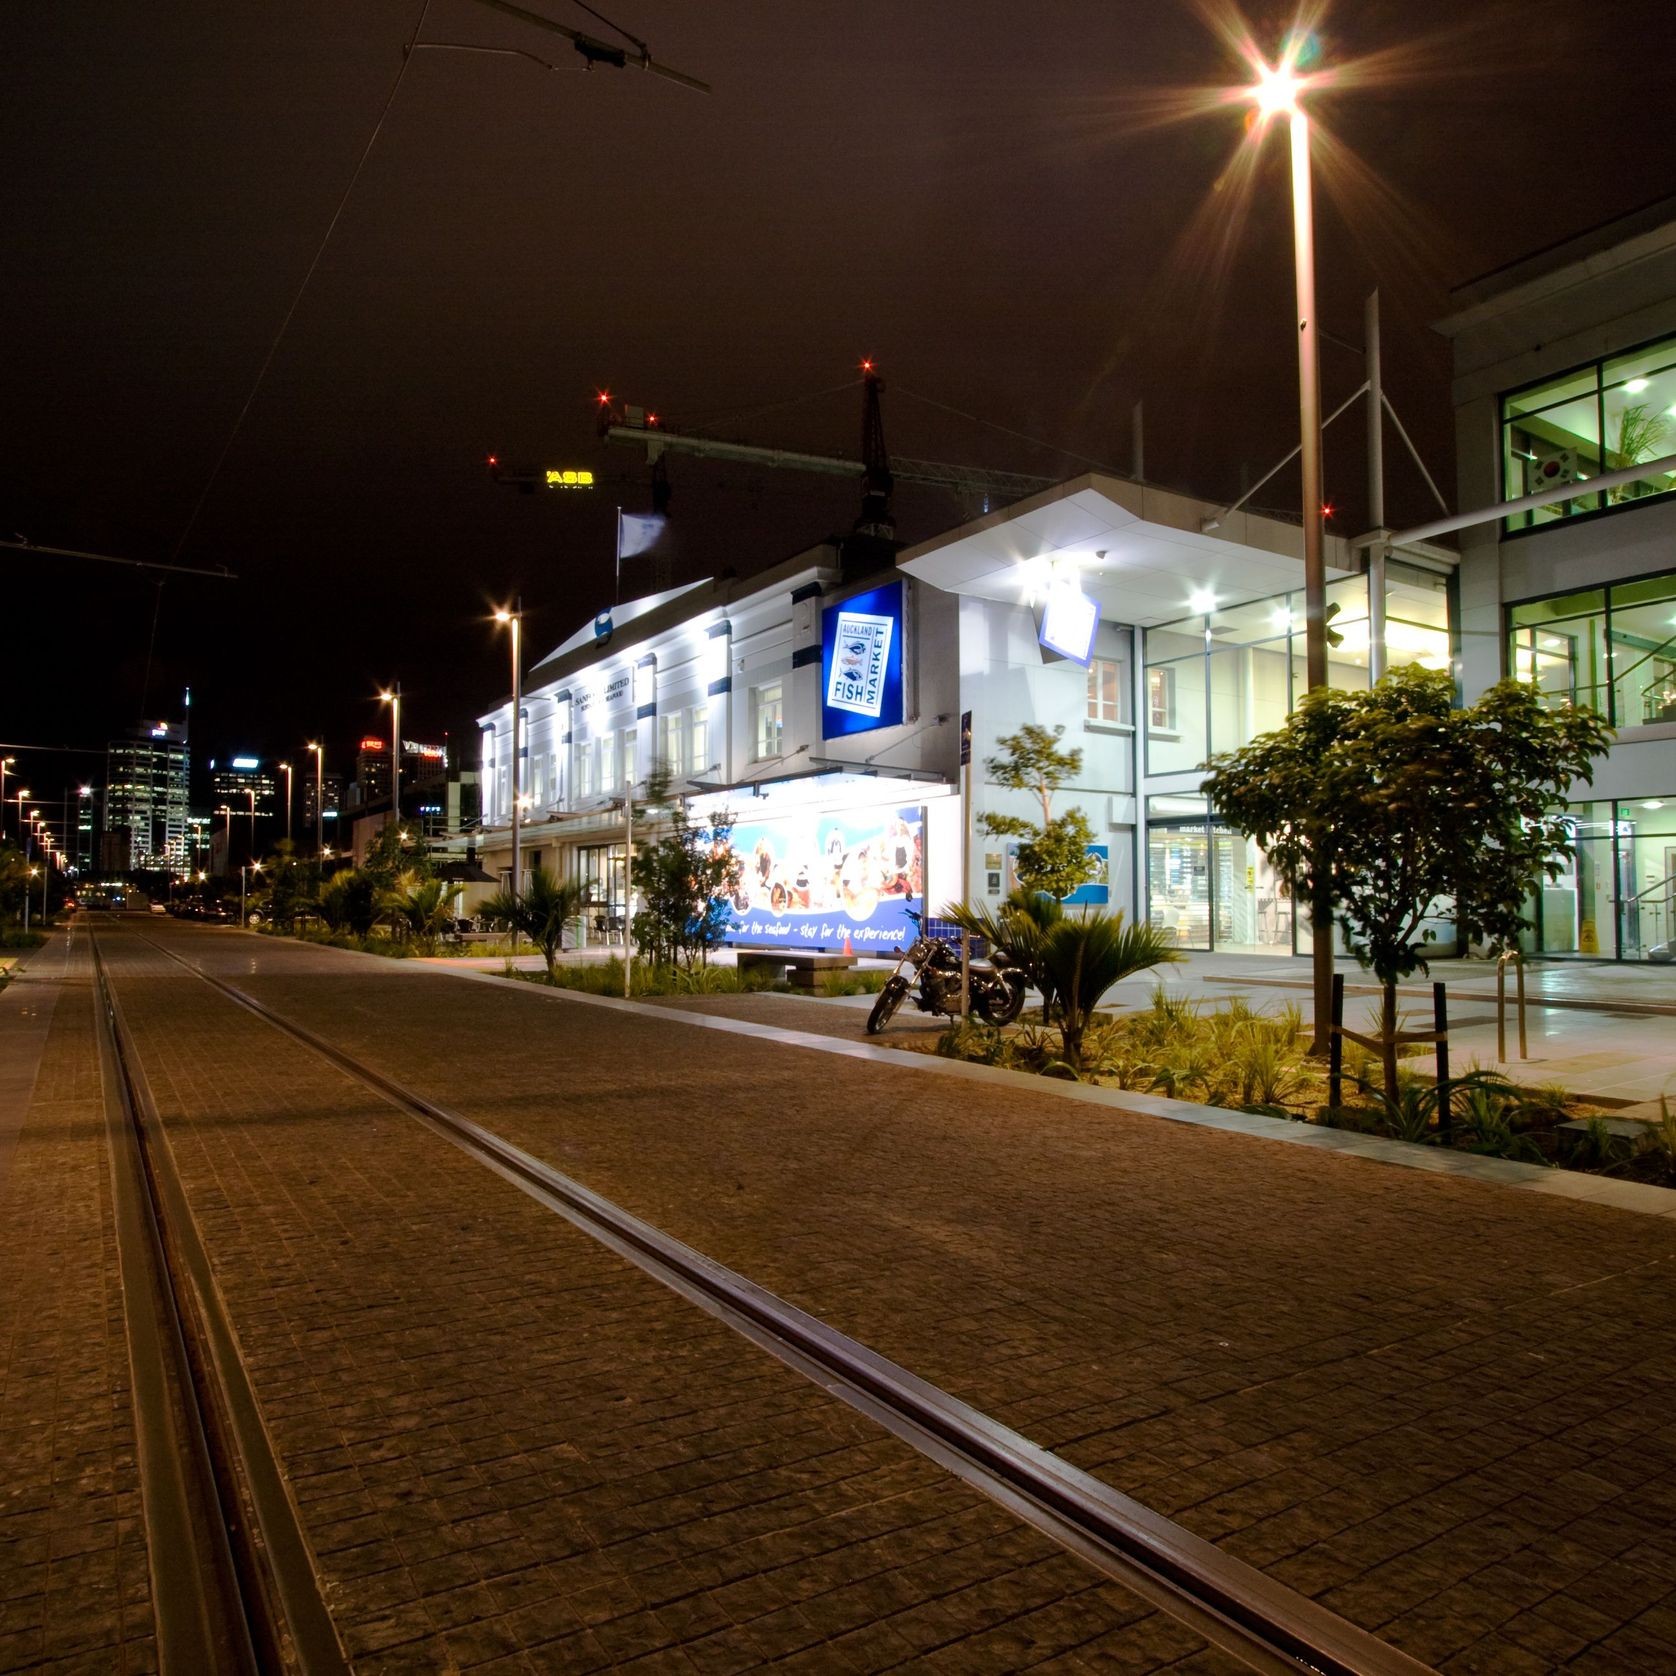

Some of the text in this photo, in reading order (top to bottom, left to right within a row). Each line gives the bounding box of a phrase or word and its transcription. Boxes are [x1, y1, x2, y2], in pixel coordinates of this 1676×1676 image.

[547, 471, 593, 484] ASB
[843, 624, 873, 637] AUCKLAND
[866, 627, 884, 705] MARKET
[604, 677, 630, 693] LIMITED
[834, 681, 865, 702] FISH
[1180, 825, 1205, 833] market
[751, 921, 763, 935] the
[765, 921, 791, 936] seafood
[800, 923, 818, 938] stay
[821, 923, 834, 939] for
[837, 924, 851, 940] the
[854, 925, 906, 942] experience!
